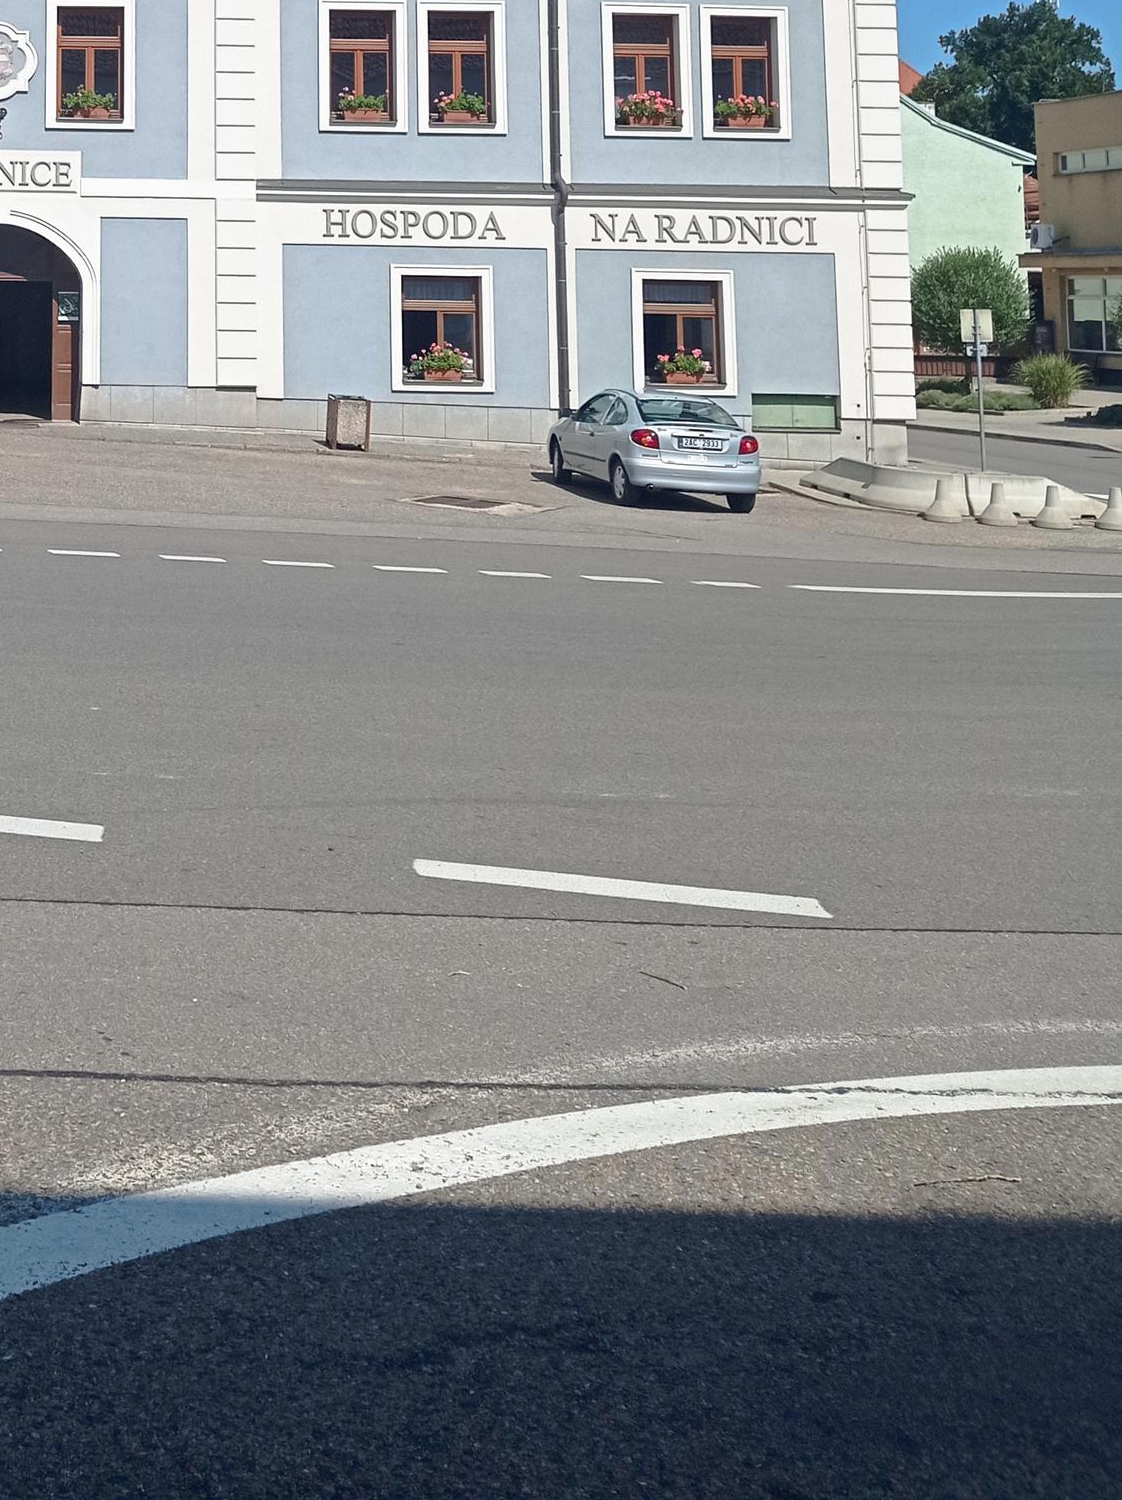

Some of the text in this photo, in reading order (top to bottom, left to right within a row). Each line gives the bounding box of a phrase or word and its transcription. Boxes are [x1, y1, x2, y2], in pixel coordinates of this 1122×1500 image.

[322, 208, 506, 241] HOSPODA
[589, 213, 818, 246] NA RADNICI
[684, 438, 719, 448] 2AC 2933
